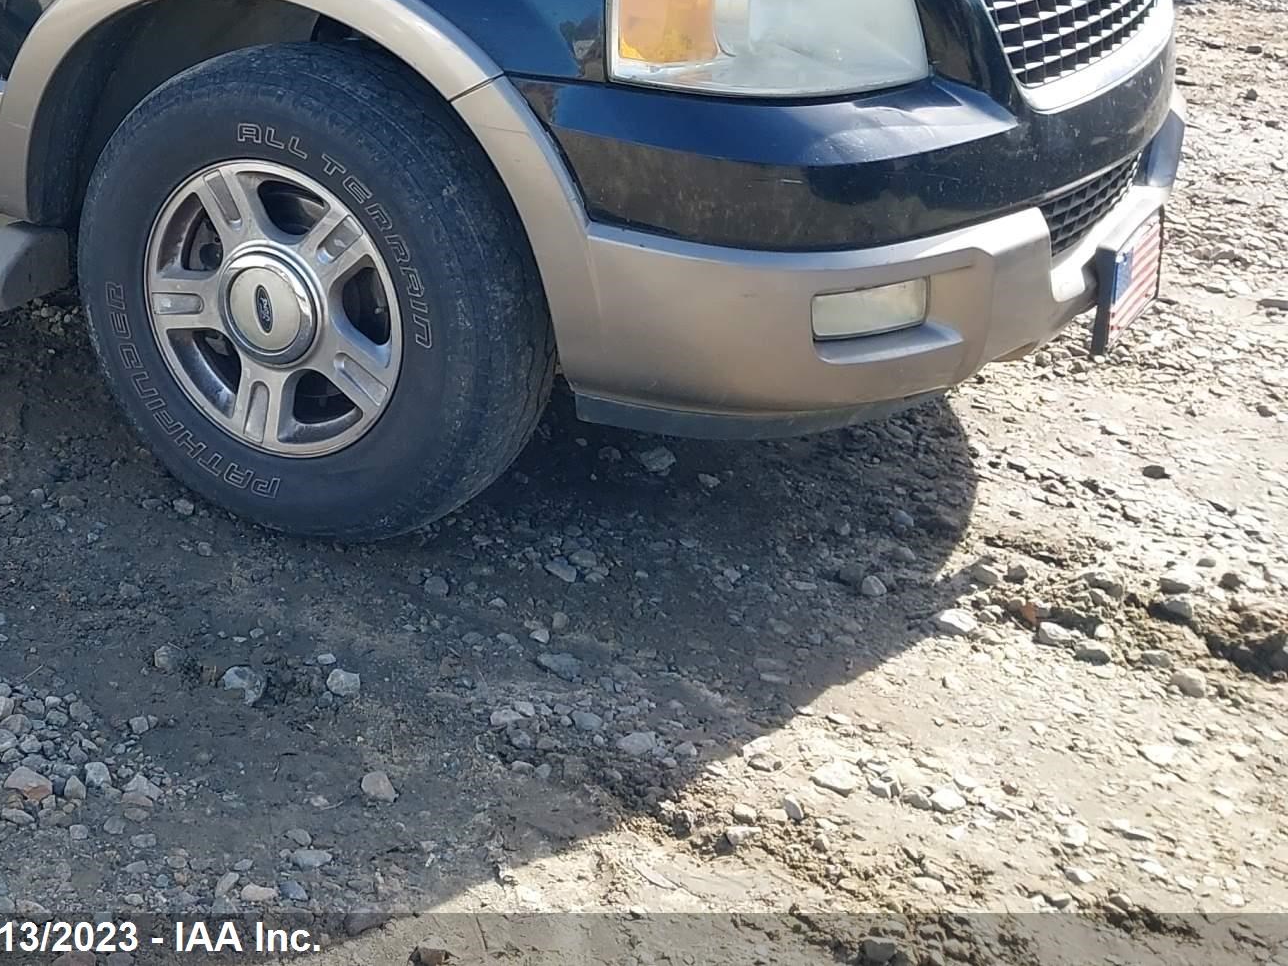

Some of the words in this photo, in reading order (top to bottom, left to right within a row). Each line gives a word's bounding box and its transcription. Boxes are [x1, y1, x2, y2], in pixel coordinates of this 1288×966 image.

[237, 123, 308, 160] ALL
[321, 154, 432, 349] TERRAIN
[105, 282, 281, 499] PATHFINDER
